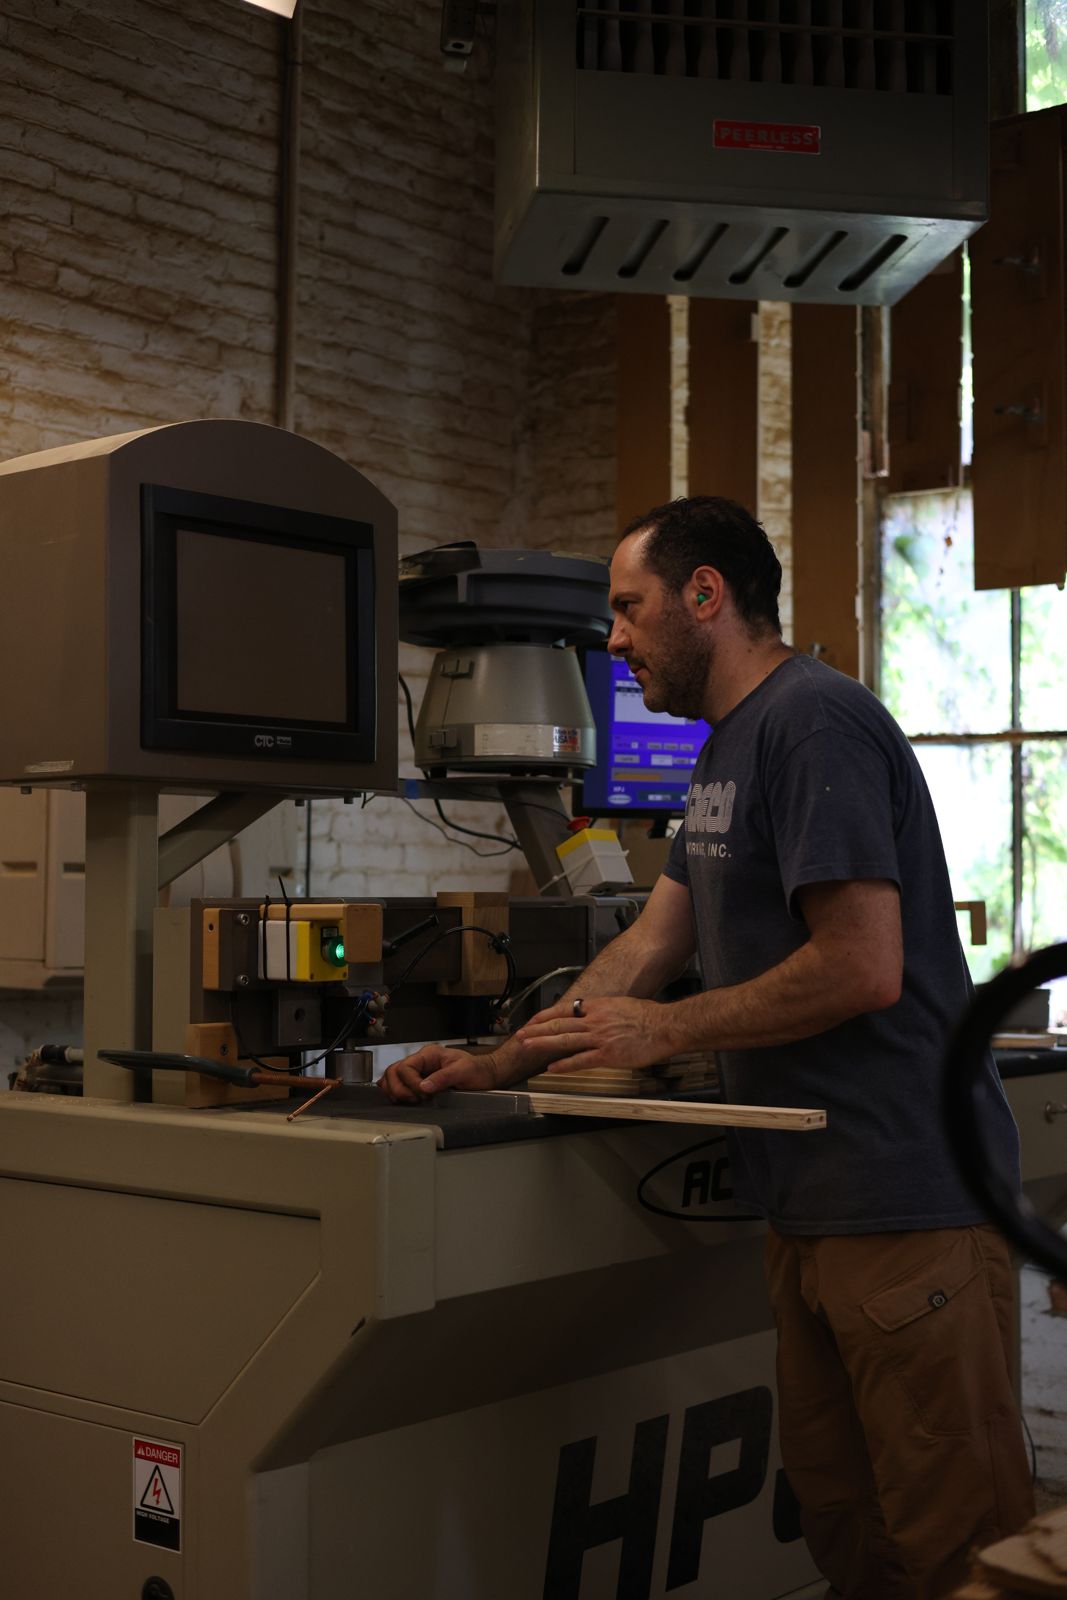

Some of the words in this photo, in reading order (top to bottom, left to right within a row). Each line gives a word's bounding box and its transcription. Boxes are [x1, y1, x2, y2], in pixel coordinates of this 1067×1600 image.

[719, 126, 814, 145] PEERLESS
[707, 843, 731, 858] INC.
[145, 1446, 179, 1464] DANGER
